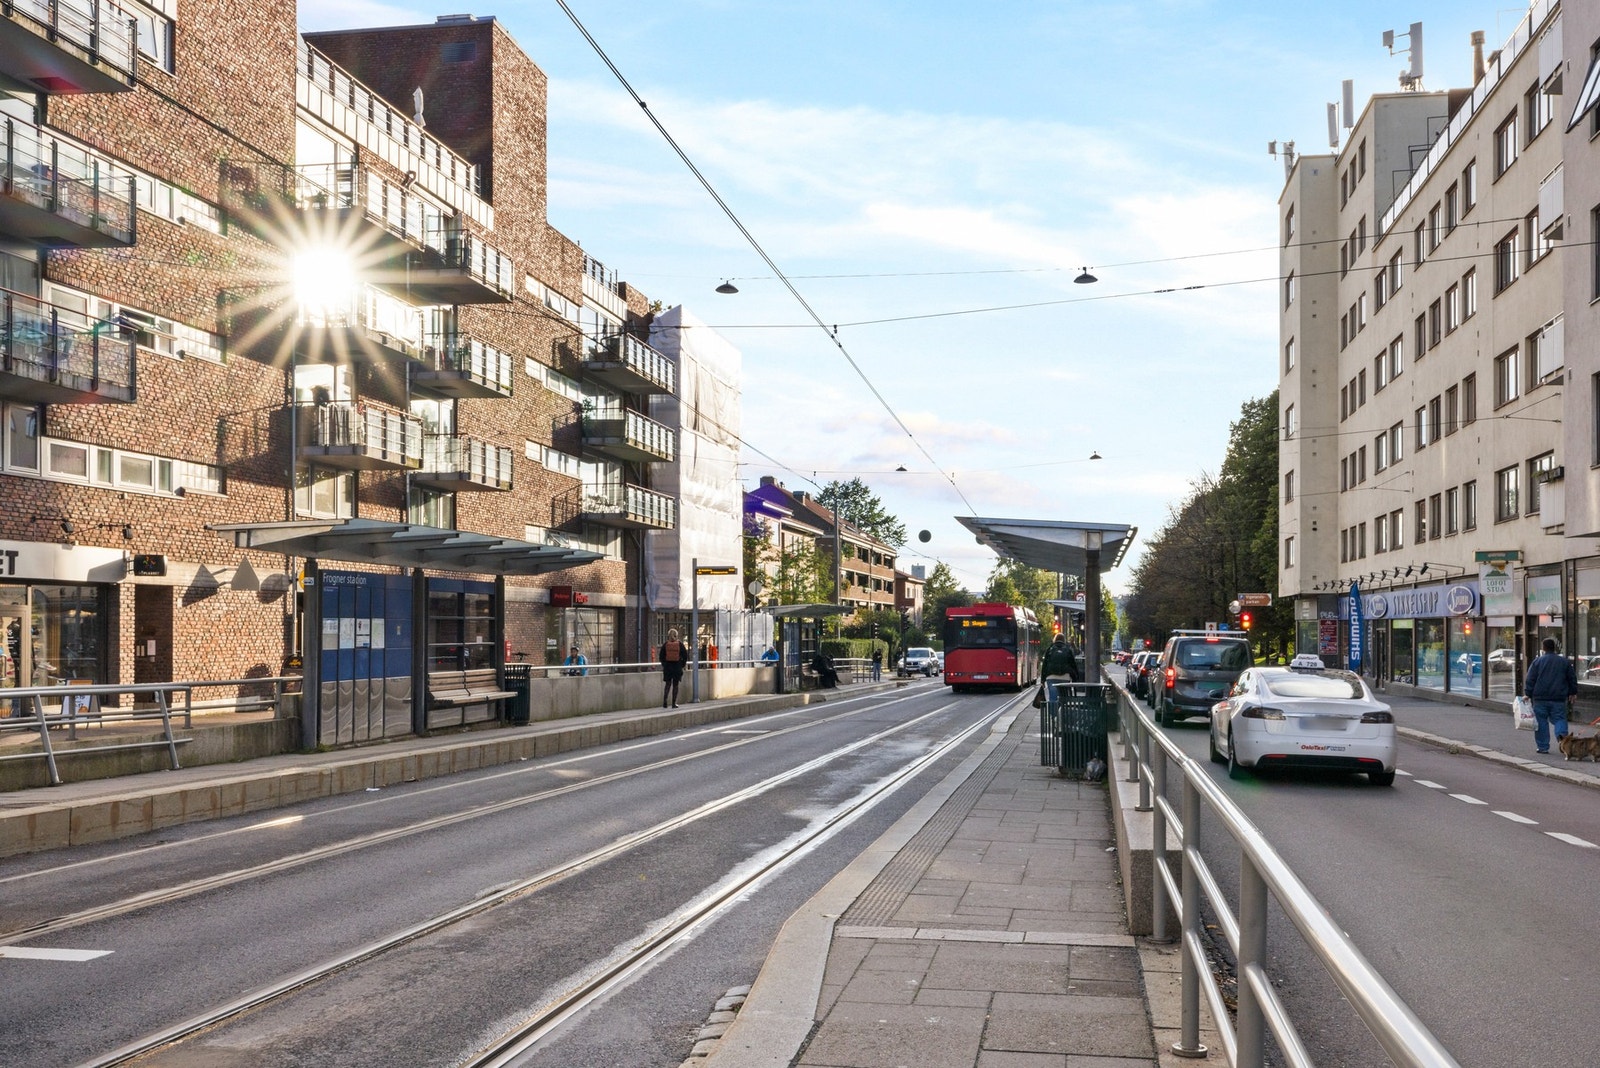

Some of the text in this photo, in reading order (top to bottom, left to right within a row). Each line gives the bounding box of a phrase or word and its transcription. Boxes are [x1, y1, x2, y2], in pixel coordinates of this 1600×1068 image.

[323, 573, 346, 585] Frogner
[1393, 591, 1439, 616] SYKKELSHOP
[1350, 597, 1360, 660] SHIMANO
